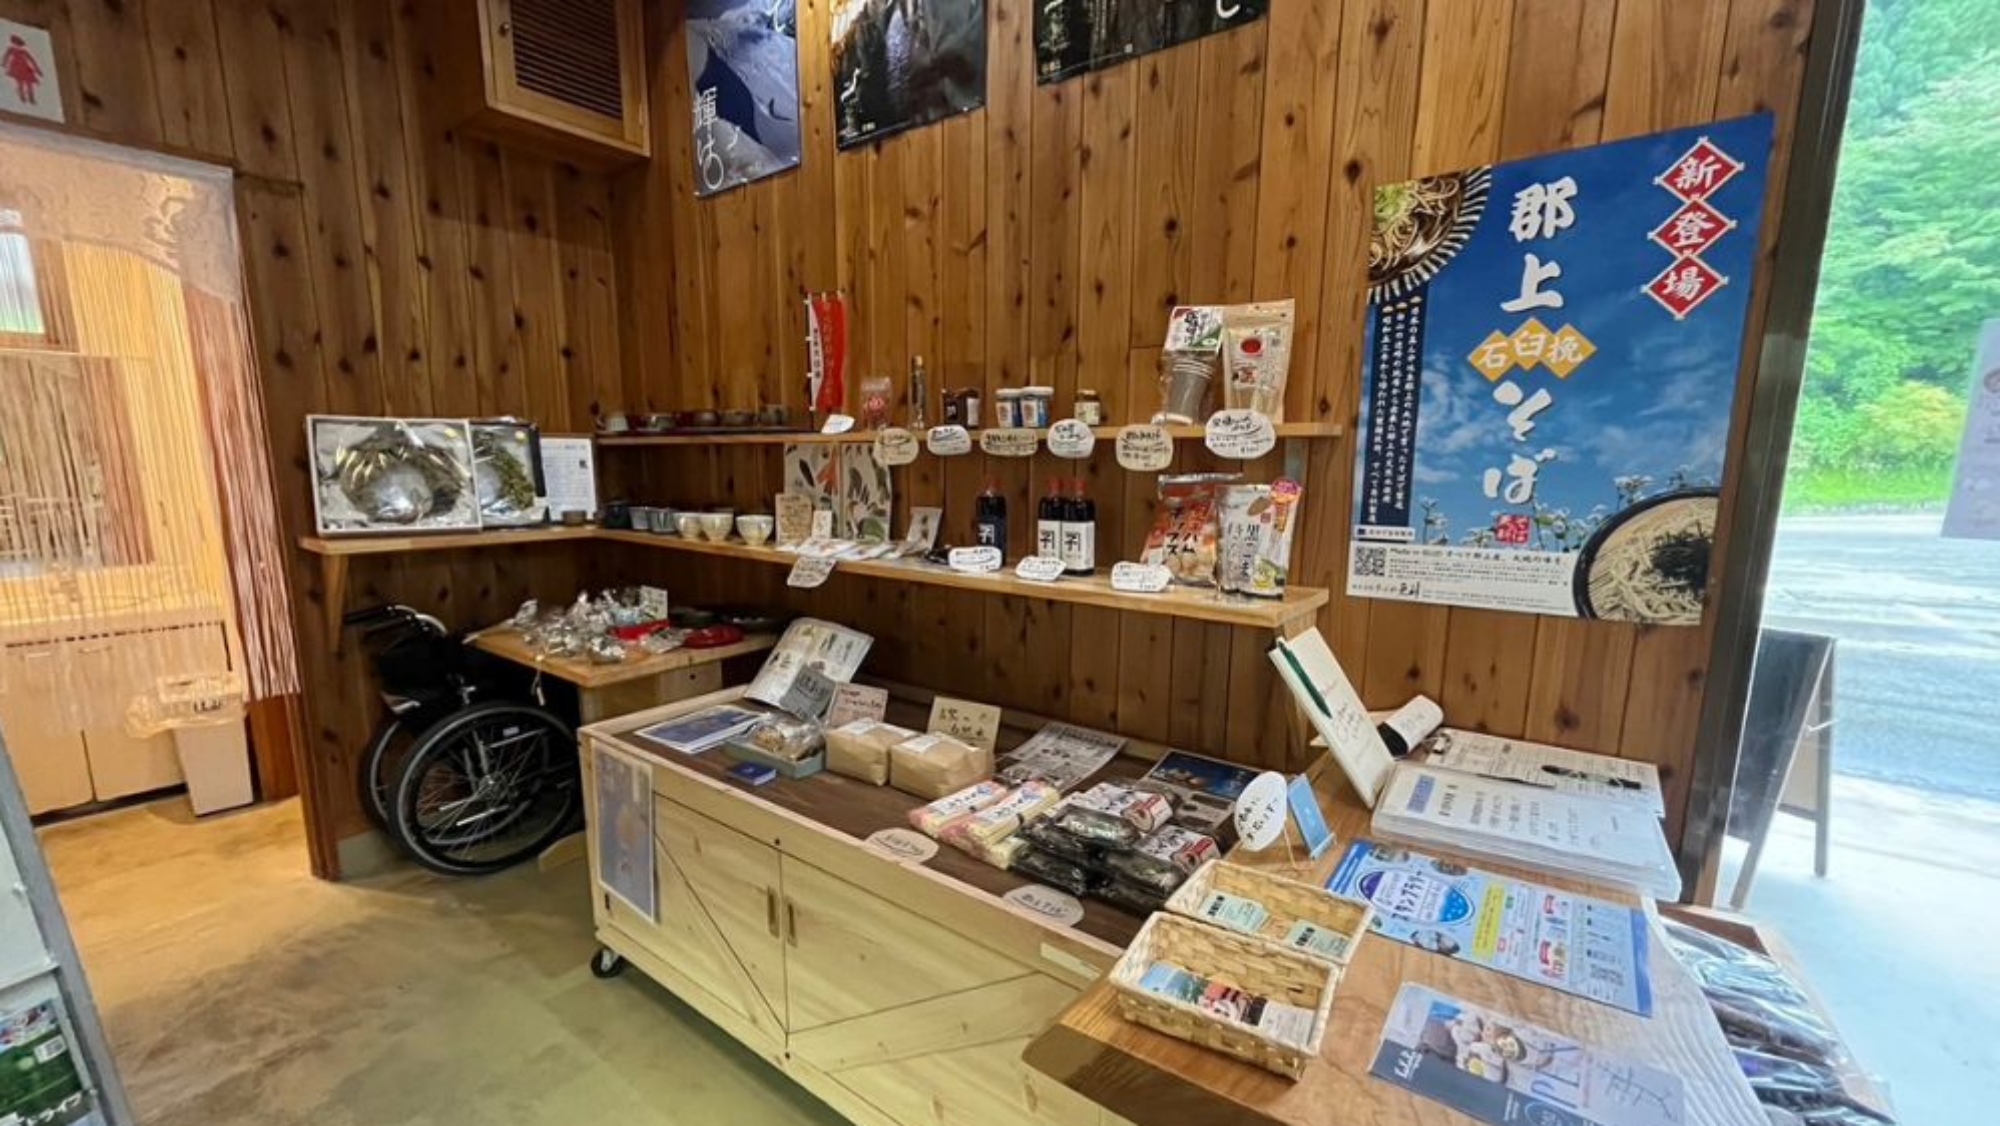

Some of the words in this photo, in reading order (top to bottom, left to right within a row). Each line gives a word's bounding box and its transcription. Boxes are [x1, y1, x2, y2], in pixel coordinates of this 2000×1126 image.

[1501, 176, 1578, 312] 郡上
[1664, 155, 1719, 302] 新登場
[1480, 330, 1584, 370] 石臼挽
[1483, 380, 1557, 505] そば
